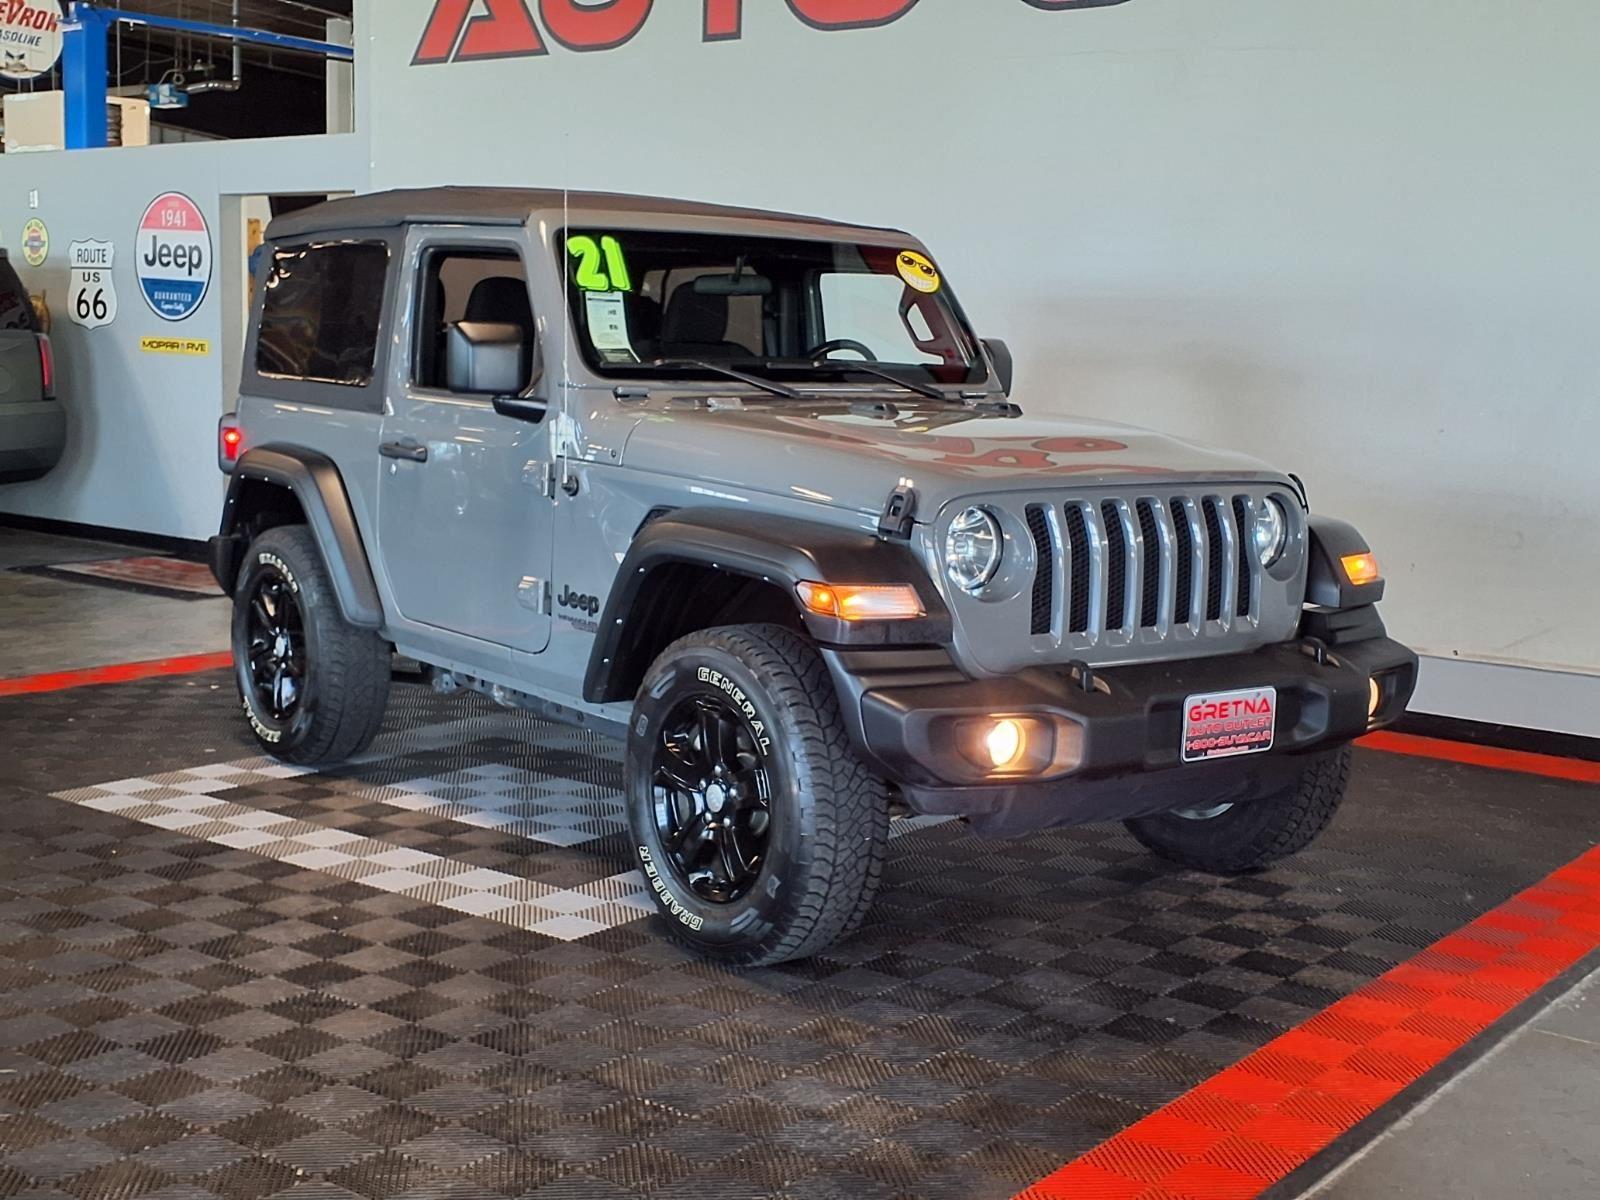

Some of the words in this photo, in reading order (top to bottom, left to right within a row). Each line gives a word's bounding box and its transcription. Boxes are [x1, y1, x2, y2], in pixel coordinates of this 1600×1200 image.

[161, 209, 187, 228] 1941
[77, 248, 107, 263] ROUTE
[143, 234, 203, 277] Jeep
[566, 235, 632, 292] 21
[82, 271, 101, 283] US
[77, 287, 108, 320] 66
[557, 584, 600, 617] Jeep
[697, 666, 771, 757] GENERAL
[1188, 697, 1271, 722] GRETNA
[1187, 723, 1222, 737] AUTO
[1223, 716, 1272, 732] OUTLET
[638, 844, 704, 932] GRABBER
